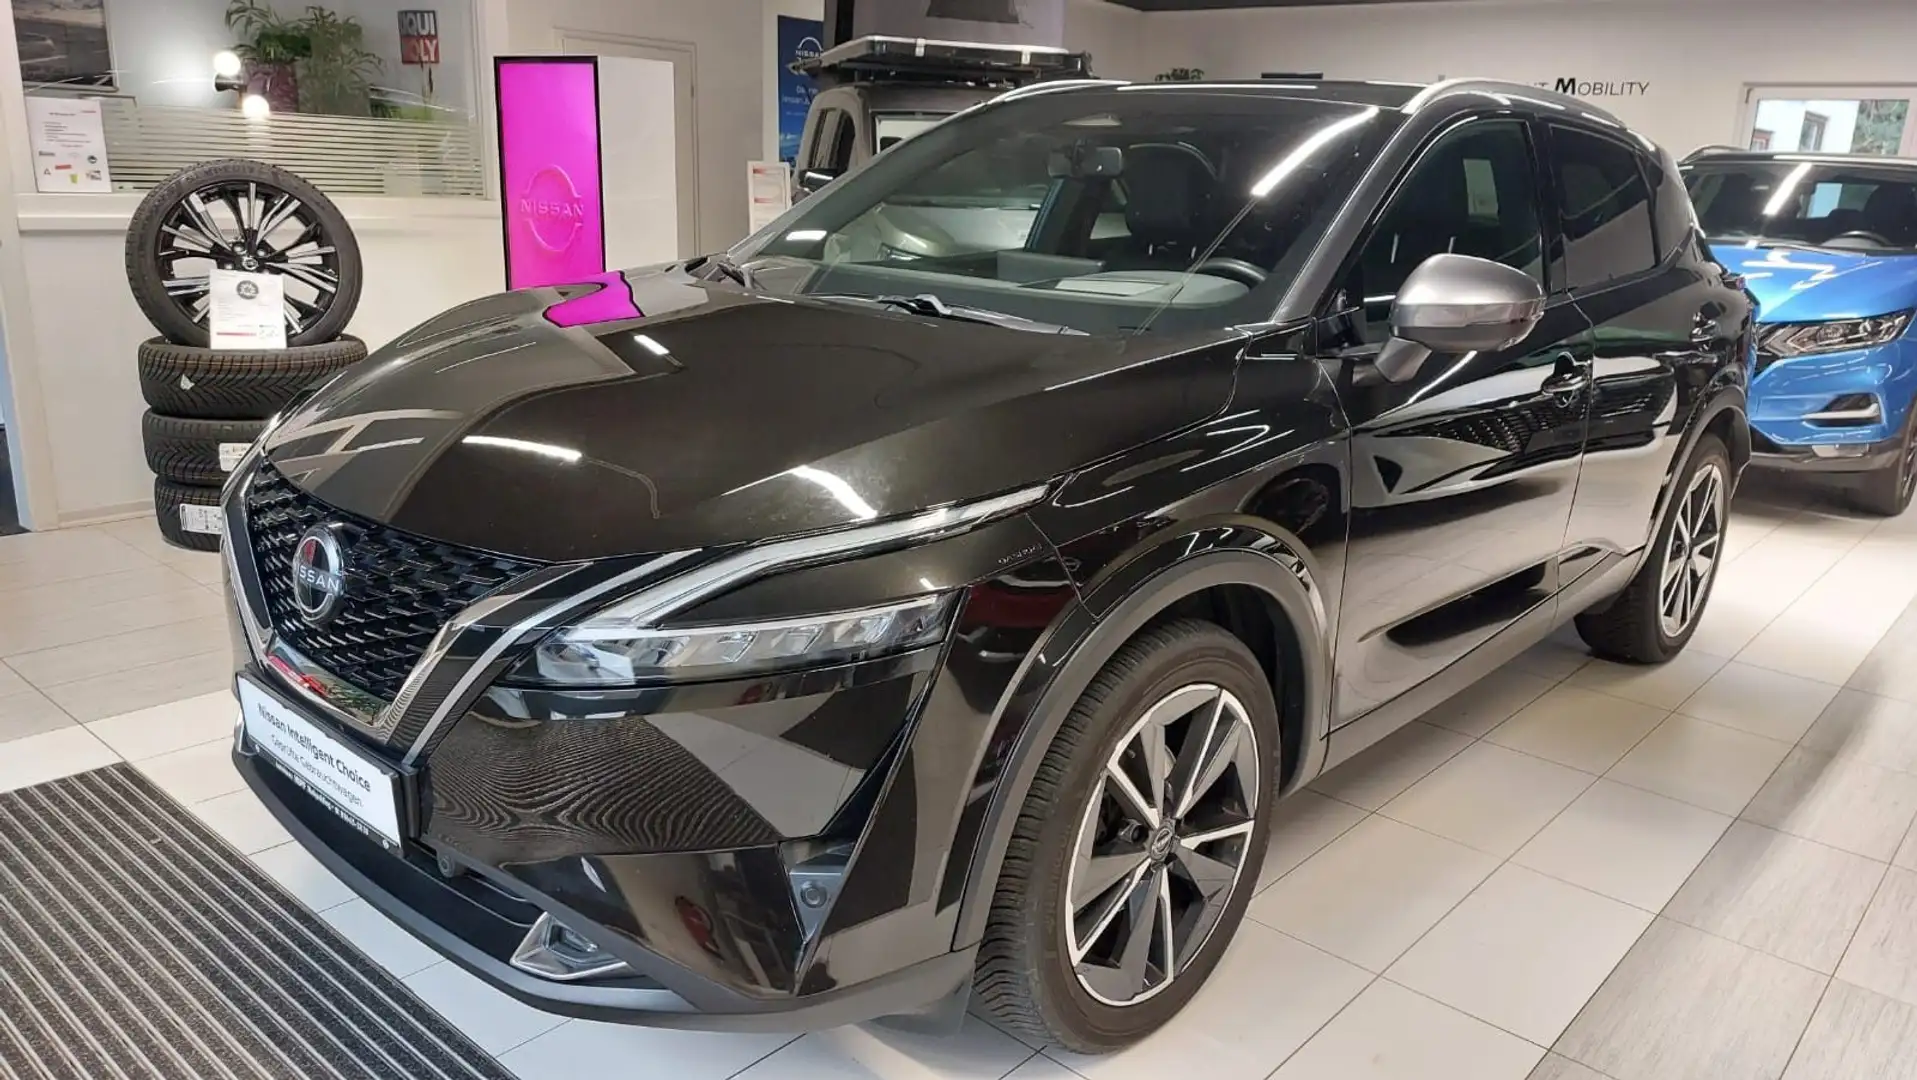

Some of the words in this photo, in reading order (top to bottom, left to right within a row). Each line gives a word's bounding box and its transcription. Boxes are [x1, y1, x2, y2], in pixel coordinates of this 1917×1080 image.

[795, 49, 820, 58] NISSA
[1555, 77, 1650, 96] MOBILITY
[520, 199, 584, 217] NISSAN
[257, 702, 288, 734] Nissan
[287, 723, 336, 769] Intelligent
[336, 759, 371, 793] Choice
